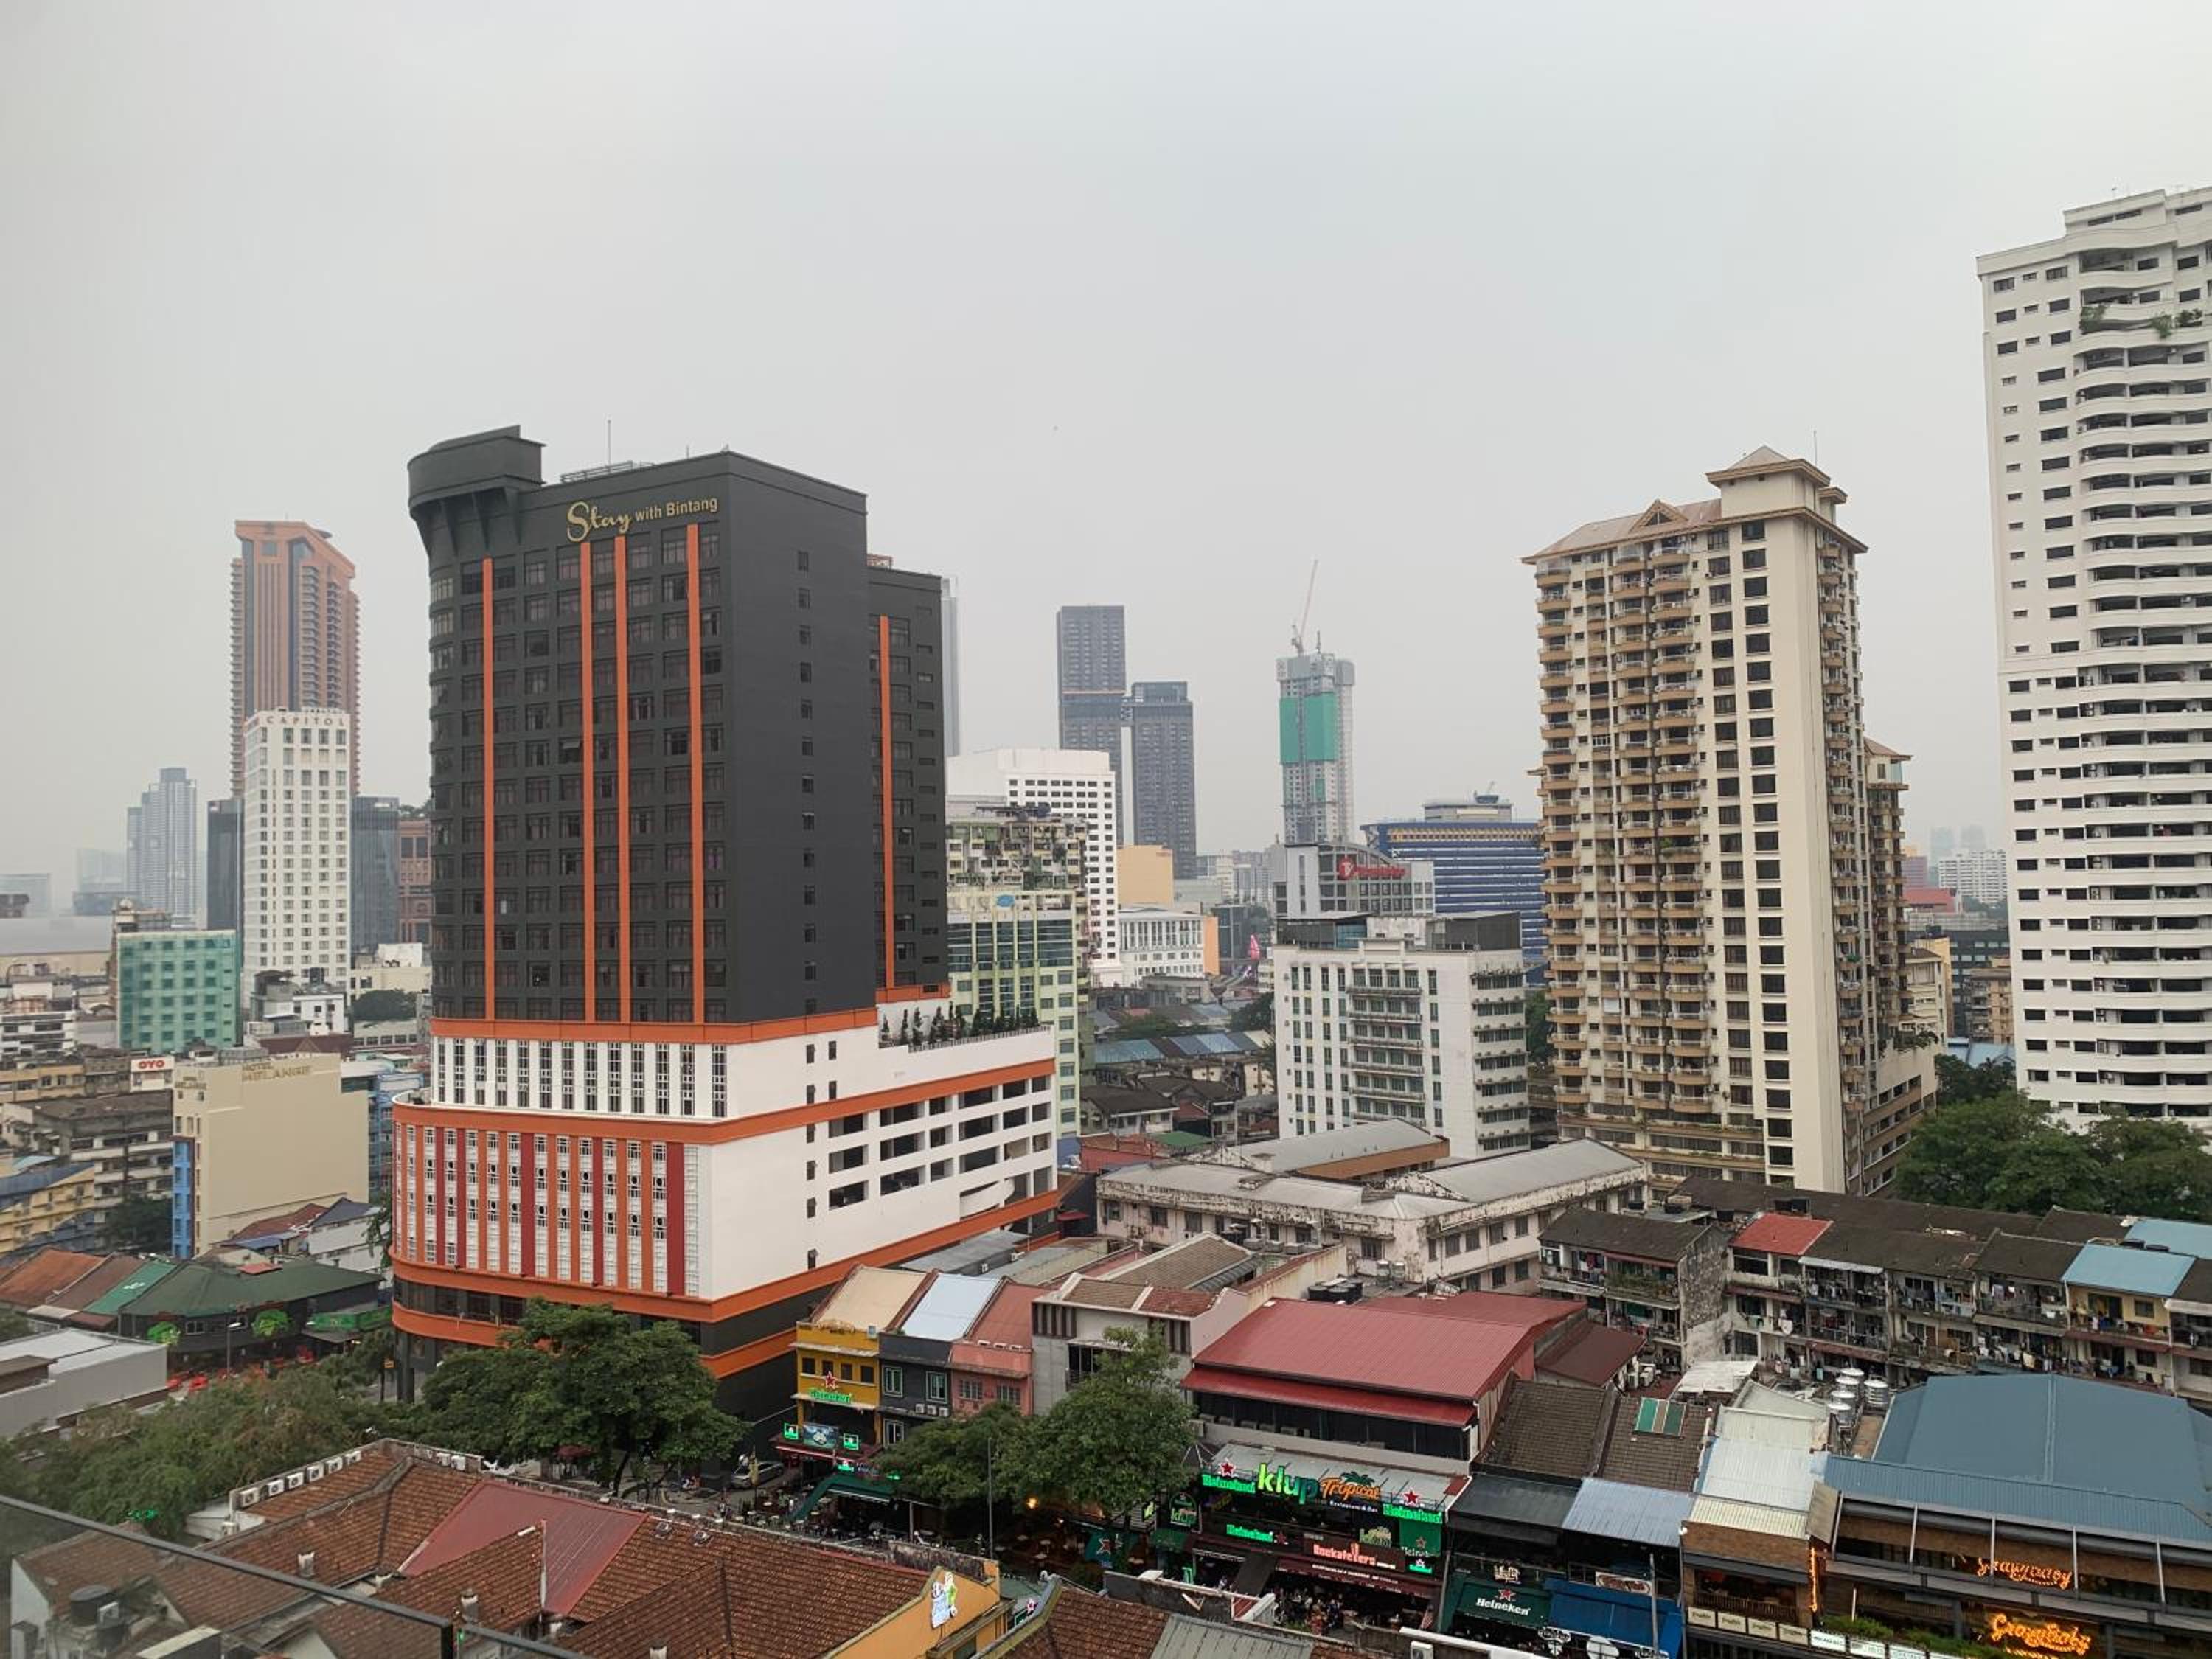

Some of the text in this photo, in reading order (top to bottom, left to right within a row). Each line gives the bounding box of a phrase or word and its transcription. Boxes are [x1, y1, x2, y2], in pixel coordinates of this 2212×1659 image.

[567, 497, 718, 542] Stay with Bintang
[138, 1060, 165, 1070] OYO
[1258, 1462, 1320, 1505] klup
[1321, 1477, 1381, 1500] Tropical
[1475, 1597, 1531, 1615] Heineken
